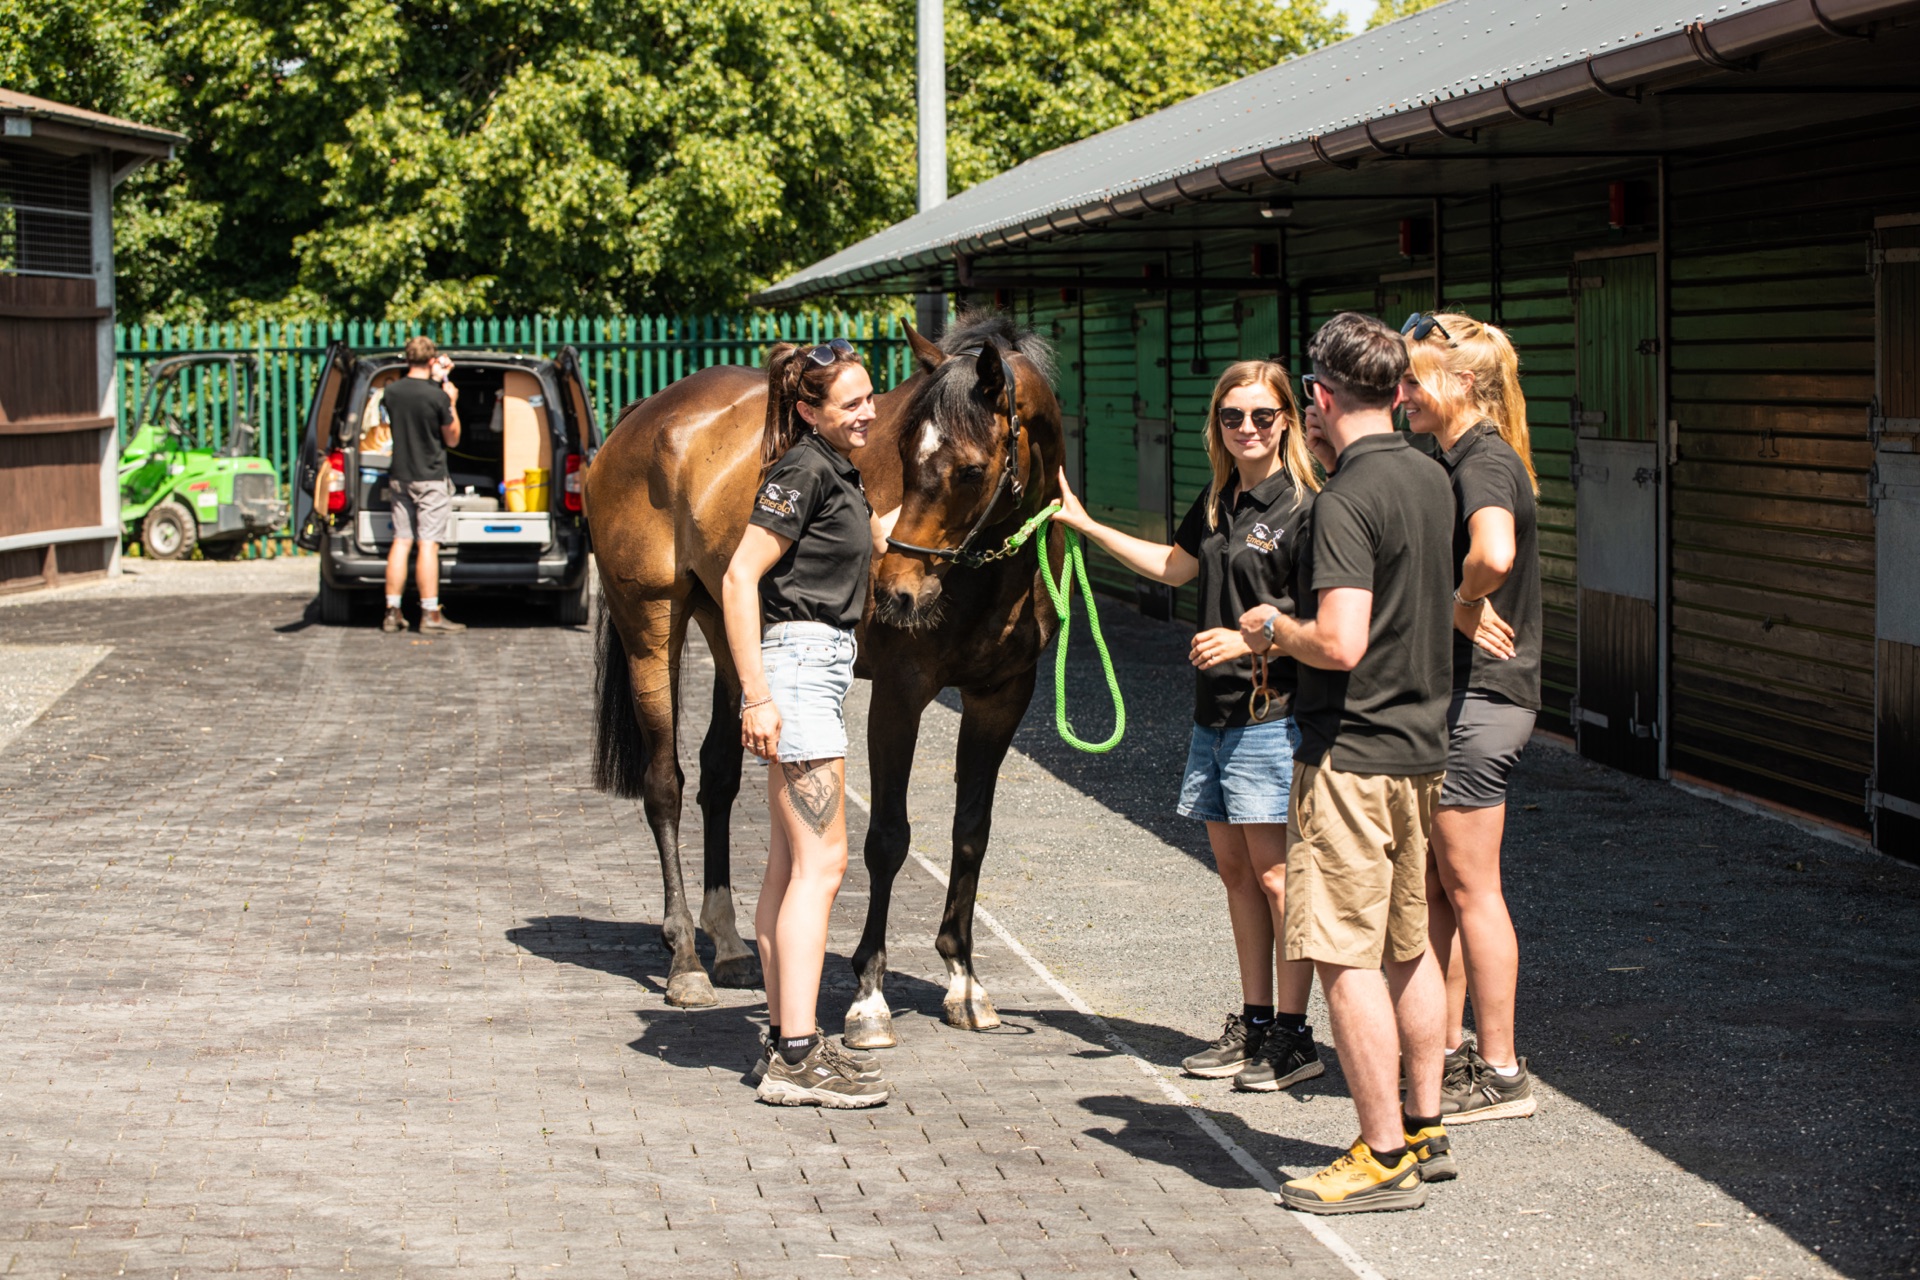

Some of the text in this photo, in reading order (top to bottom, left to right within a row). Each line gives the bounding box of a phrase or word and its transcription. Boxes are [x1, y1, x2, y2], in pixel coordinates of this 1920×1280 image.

[759, 495, 791, 514] Emerald
[1246, 534, 1274, 552] Emerald
[787, 1038, 809, 1048] PUMA
